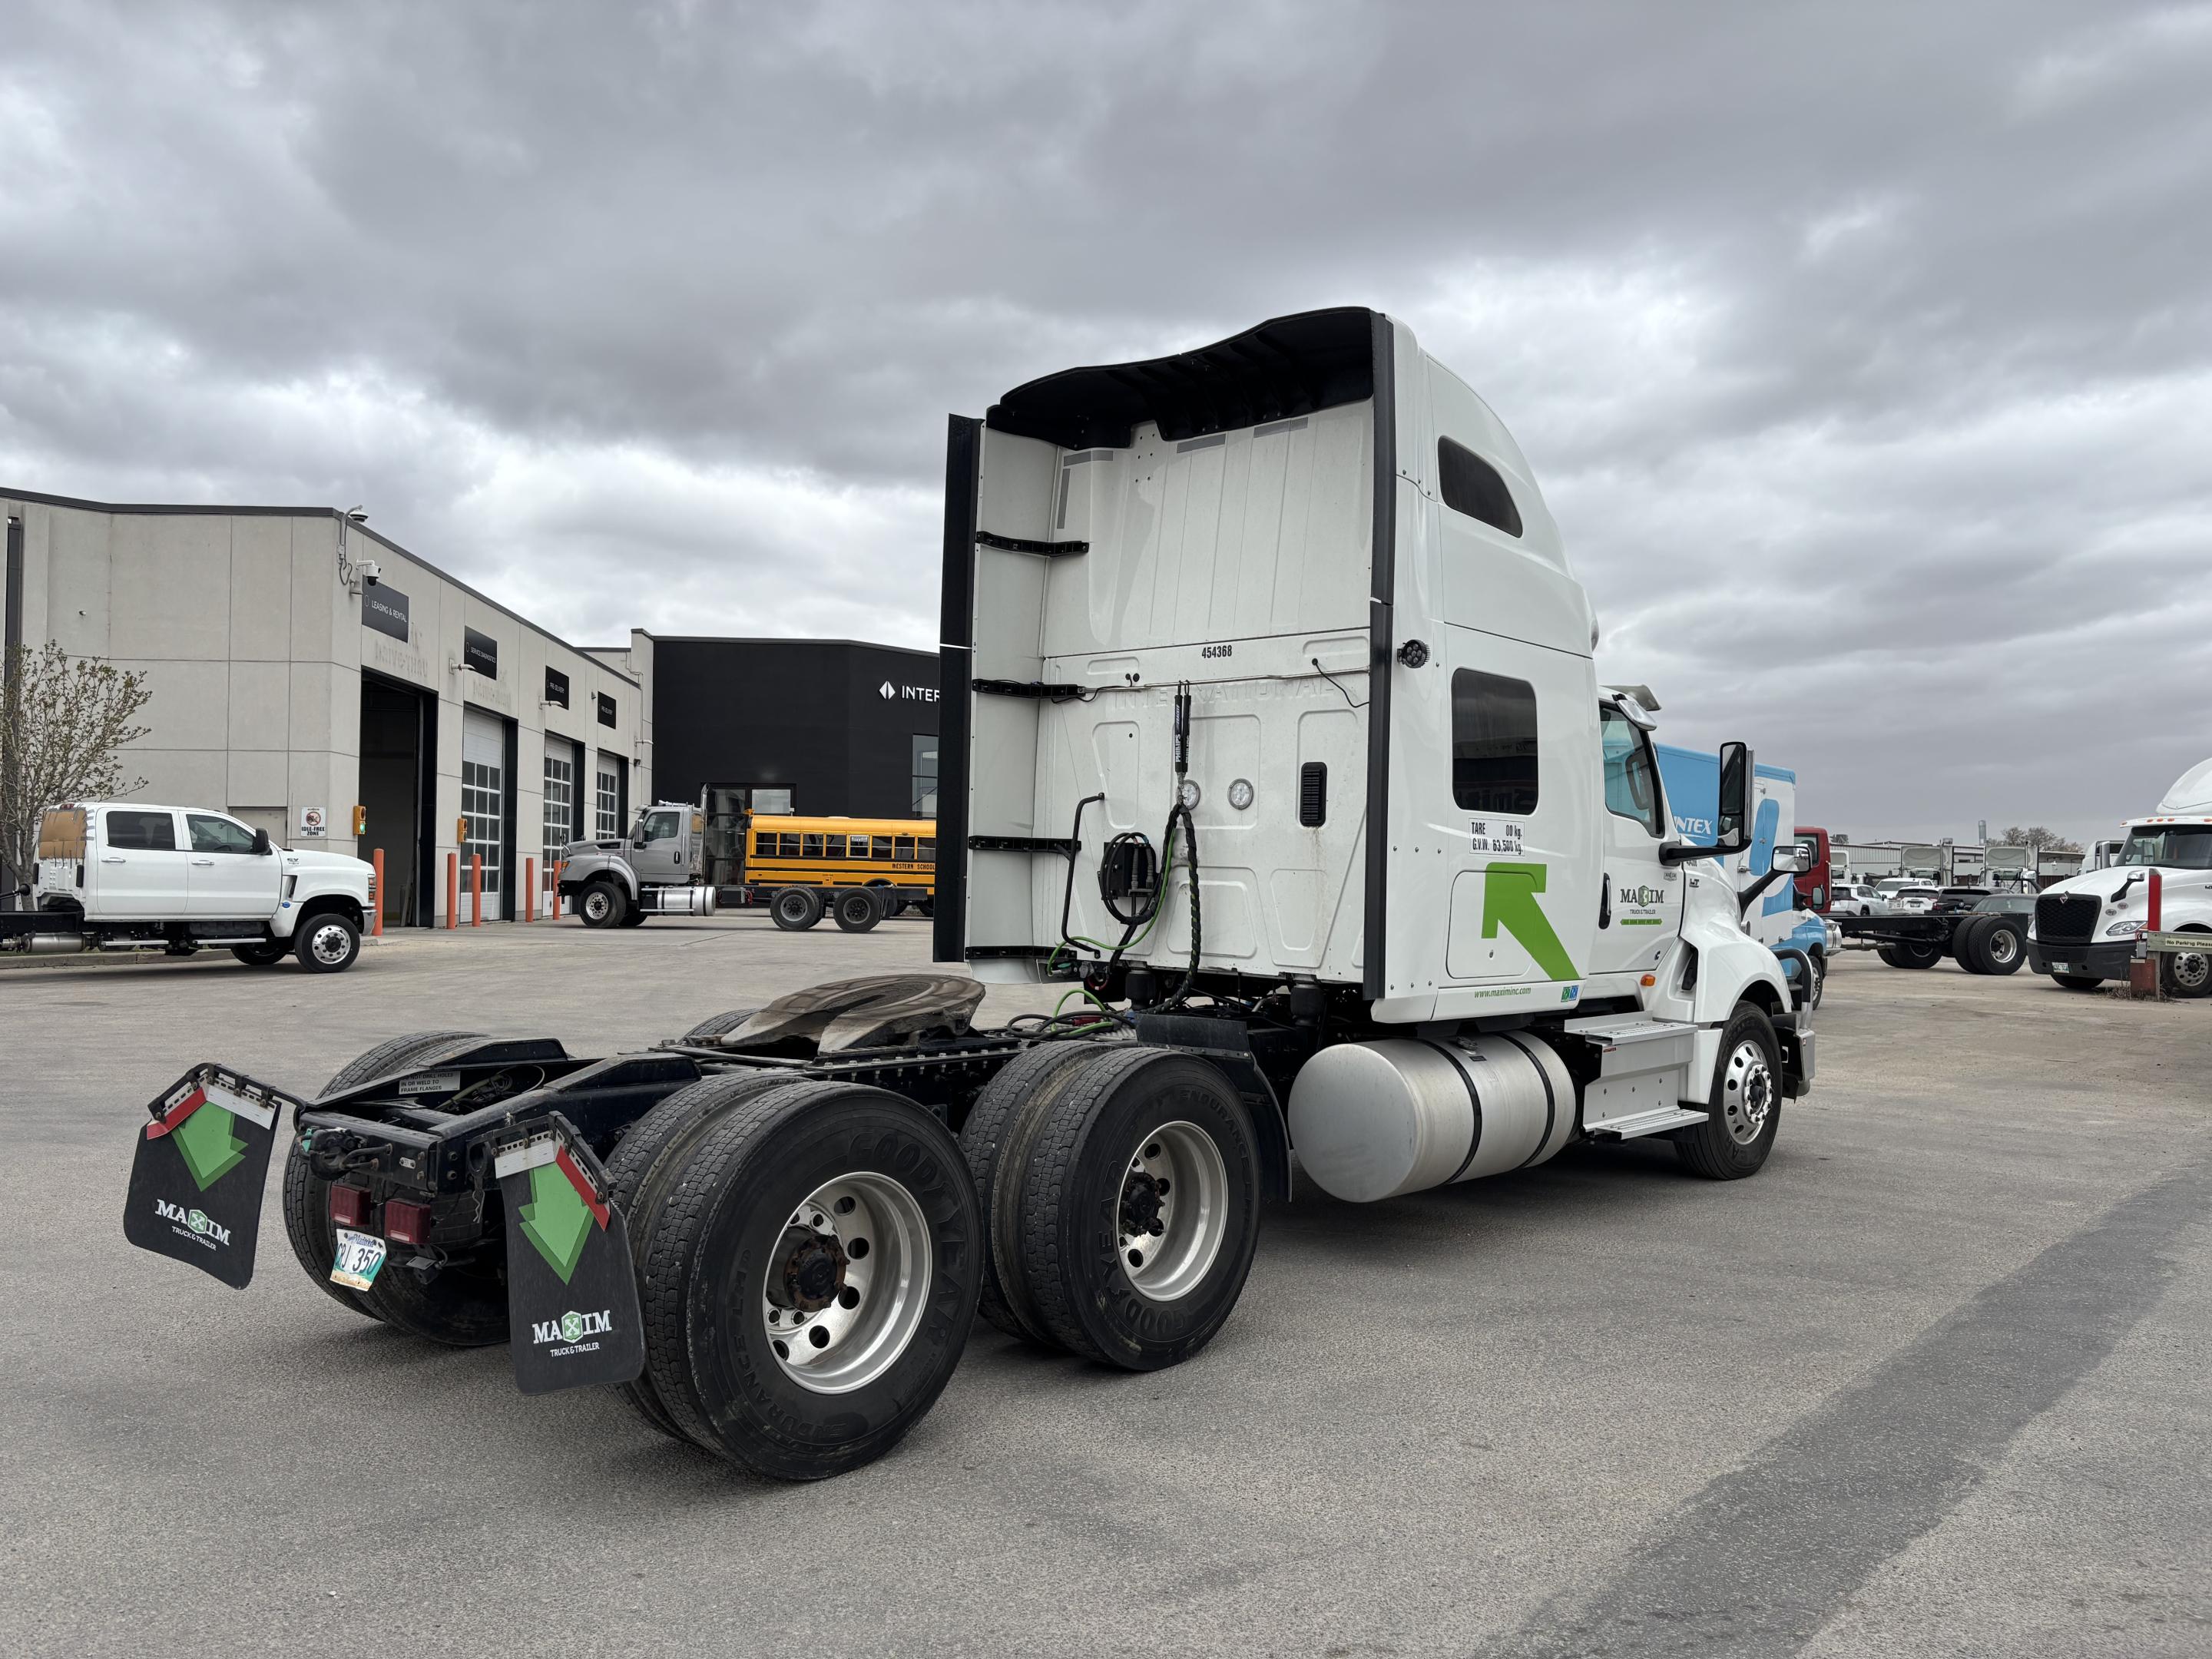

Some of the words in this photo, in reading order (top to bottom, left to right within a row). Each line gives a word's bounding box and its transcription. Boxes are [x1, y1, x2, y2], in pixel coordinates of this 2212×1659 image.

[371, 600, 388, 614] LEASING
[392, 609, 407, 623] RENTAL
[1201, 644, 1233, 659] 454368
[1471, 822, 1486, 835] TARE
[1505, 824, 1513, 836] 00
[1514, 825, 1522, 840] kg.
[1472, 838, 1490, 851] G.V.W.
[1492, 839, 1514, 853] 63,500
[1514, 840, 1524, 855] kg.
[1474, 986, 1532, 998] www.maximinc.com
[154, 1198, 231, 1247] MAXIM
[352, 1248, 382, 1275] 350
[531, 1310, 612, 1344] MAXIM
